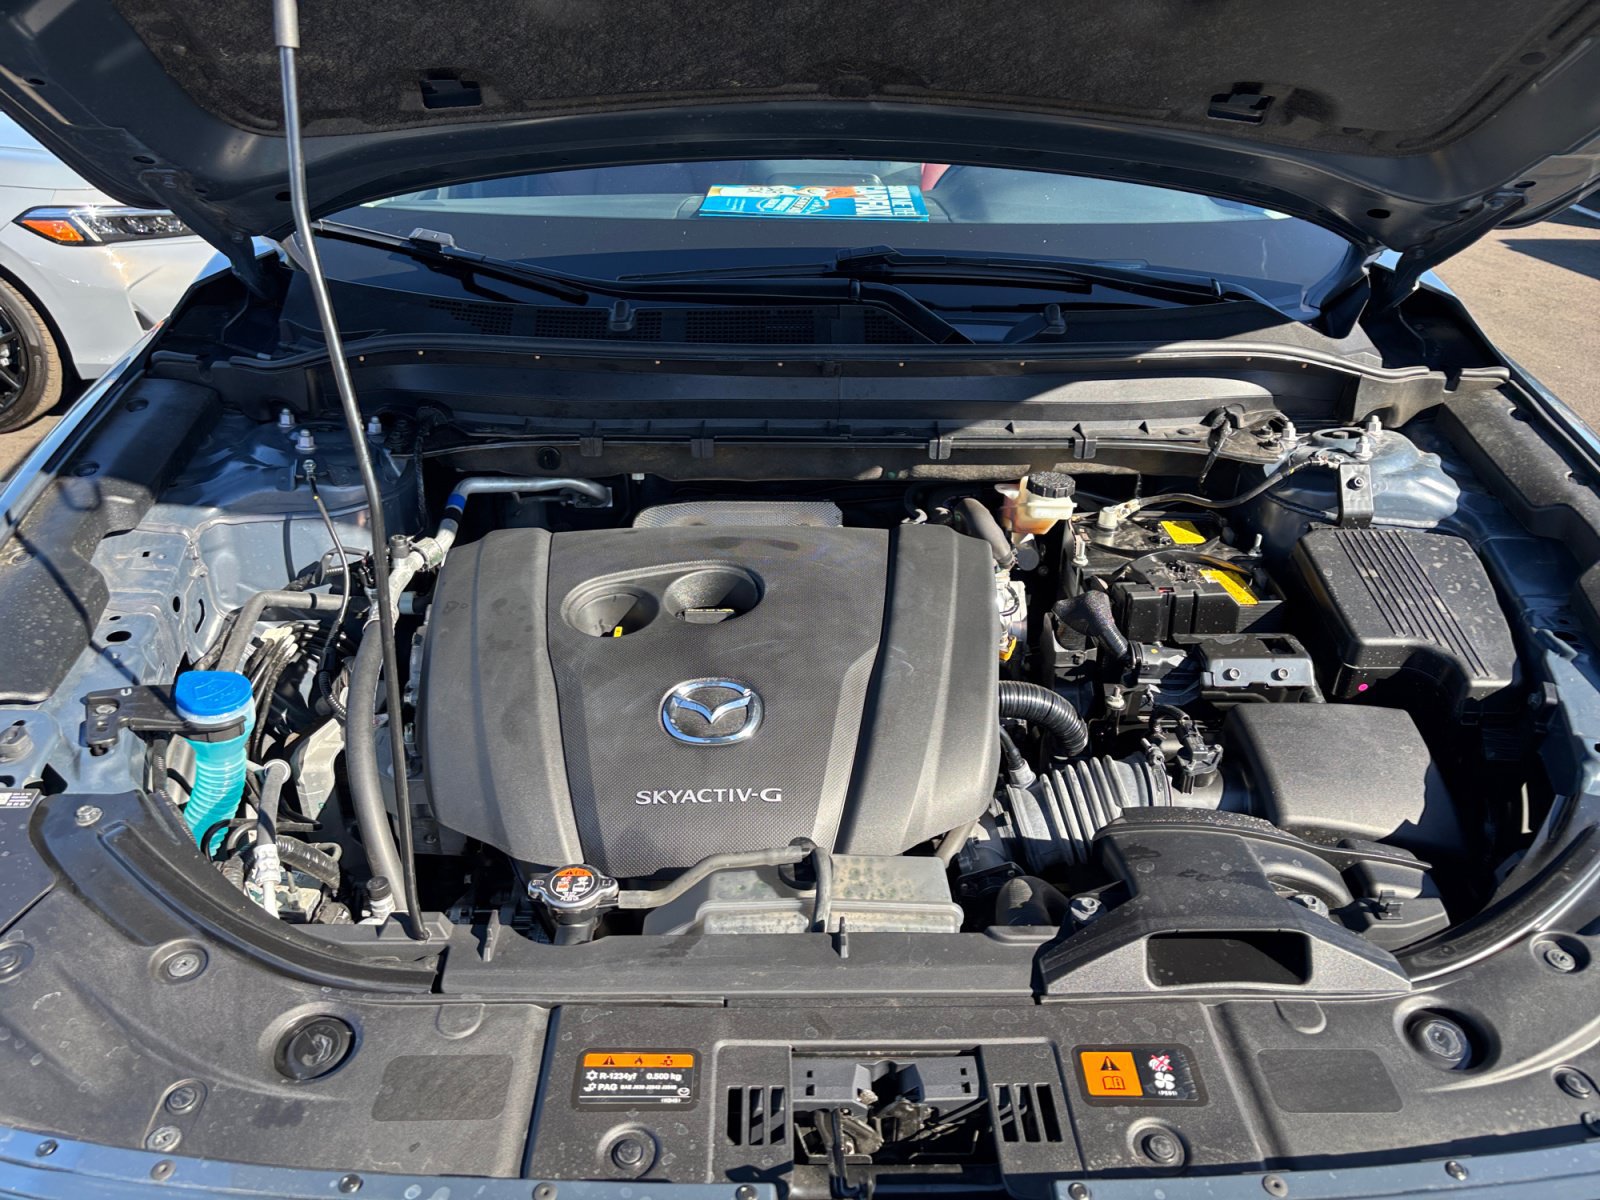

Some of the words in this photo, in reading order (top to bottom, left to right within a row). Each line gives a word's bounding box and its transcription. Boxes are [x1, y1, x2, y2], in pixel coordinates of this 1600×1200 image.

[635, 788, 783, 805] SKYACTIV-G
[599, 1072, 637, 1081] R-1234yf
[646, 1072, 669, 1080] 0.500
[670, 1072, 682, 1081] kg
[598, 1083, 618, 1091] PAG
